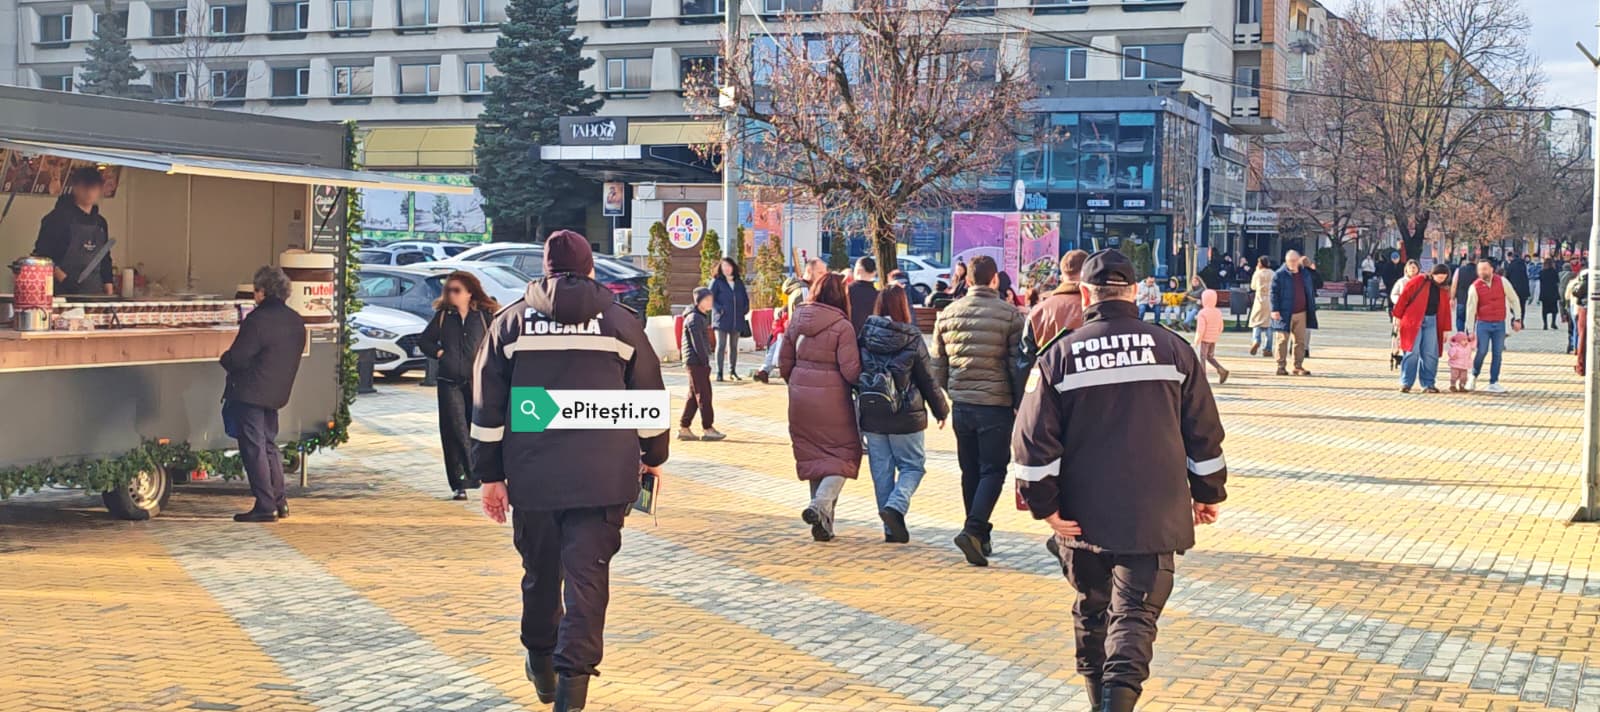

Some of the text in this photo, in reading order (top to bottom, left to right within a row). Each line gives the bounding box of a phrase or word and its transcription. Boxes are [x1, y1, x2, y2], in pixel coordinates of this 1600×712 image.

[34, 183, 46, 193] 10
[1071, 333, 1156, 356] POLIȚIA
[1074, 347, 1157, 372] LOCALĂ
